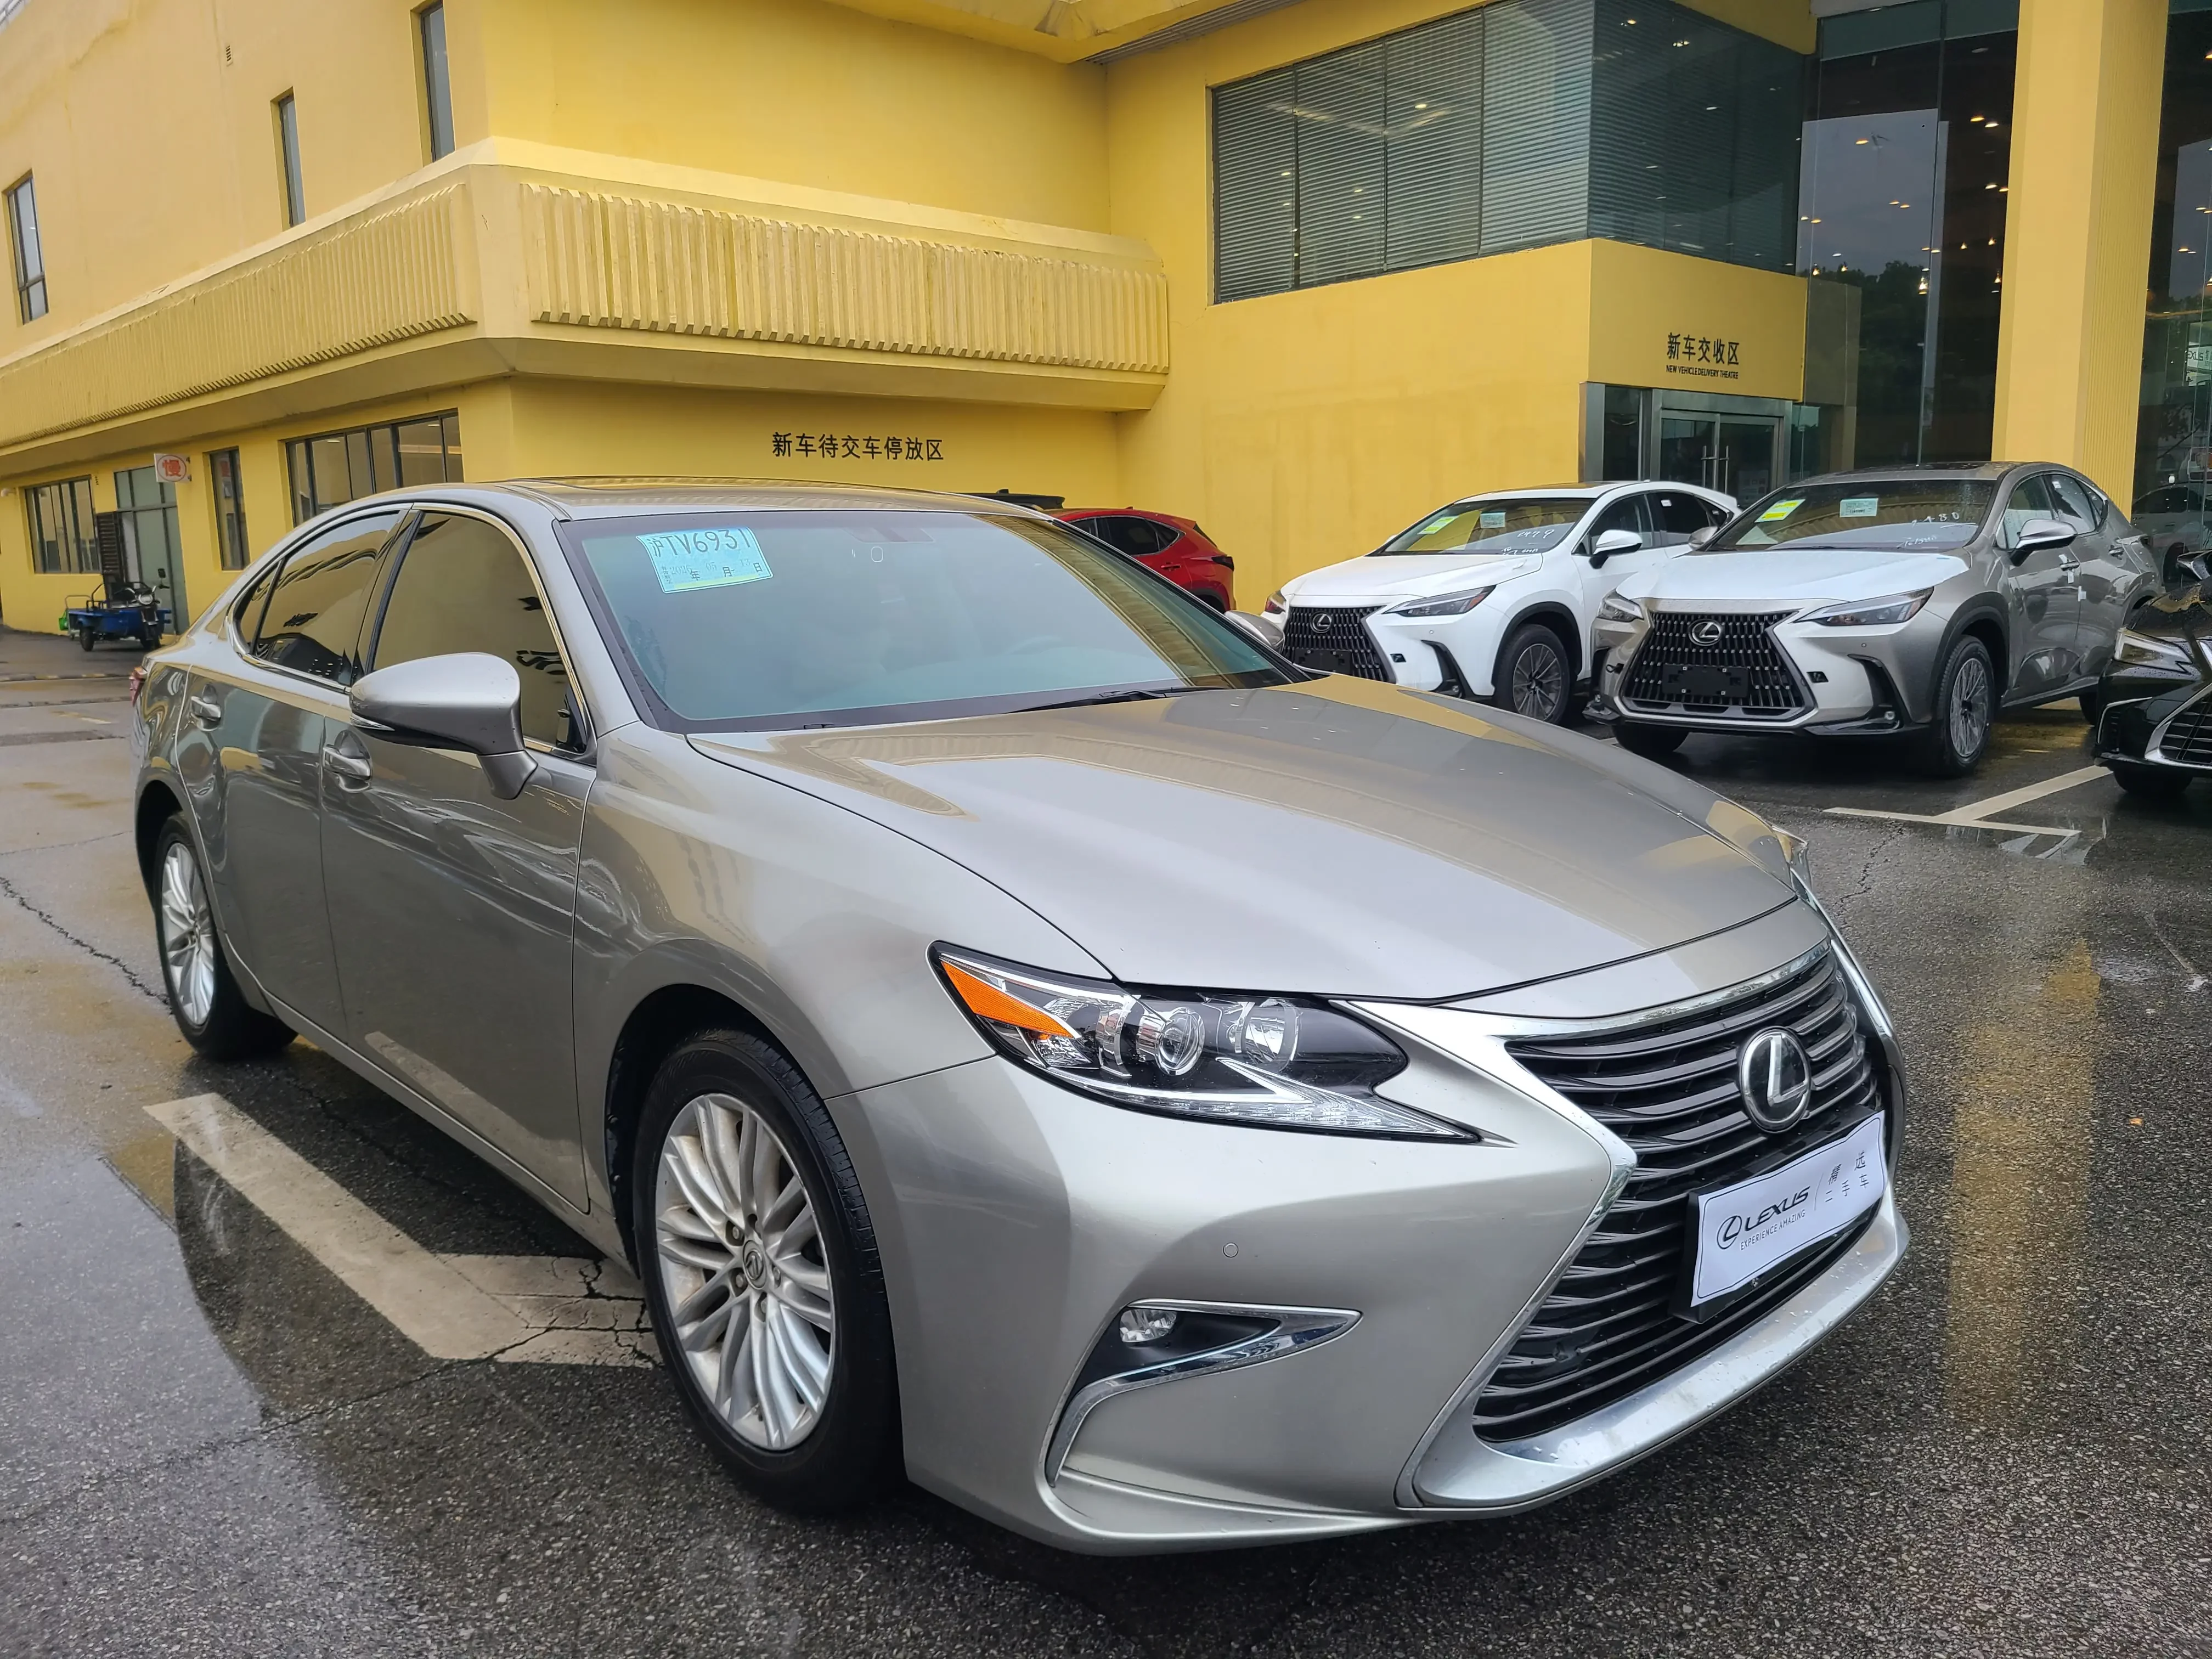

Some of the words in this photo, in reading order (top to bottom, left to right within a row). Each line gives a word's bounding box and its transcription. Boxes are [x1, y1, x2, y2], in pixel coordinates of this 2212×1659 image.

[1667, 332, 1739, 365] 新车交收区
[1678, 366, 1697, 375] VEHICLE
[1697, 368, 1719, 377] DELIVERY
[1720, 370, 1739, 379] THEATRE
[772, 432, 944, 461] 新车待交车停放区
[162, 459, 182, 477] 慢
[647, 529, 751, 557] 沪TV6931
[1825, 1173, 1869, 1203] 二手车
[1745, 1186, 1810, 1232] LEXUS
[1740, 1224, 1778, 1250] EXPERIENCE
[1779, 1209, 1805, 1230] AMAZING
